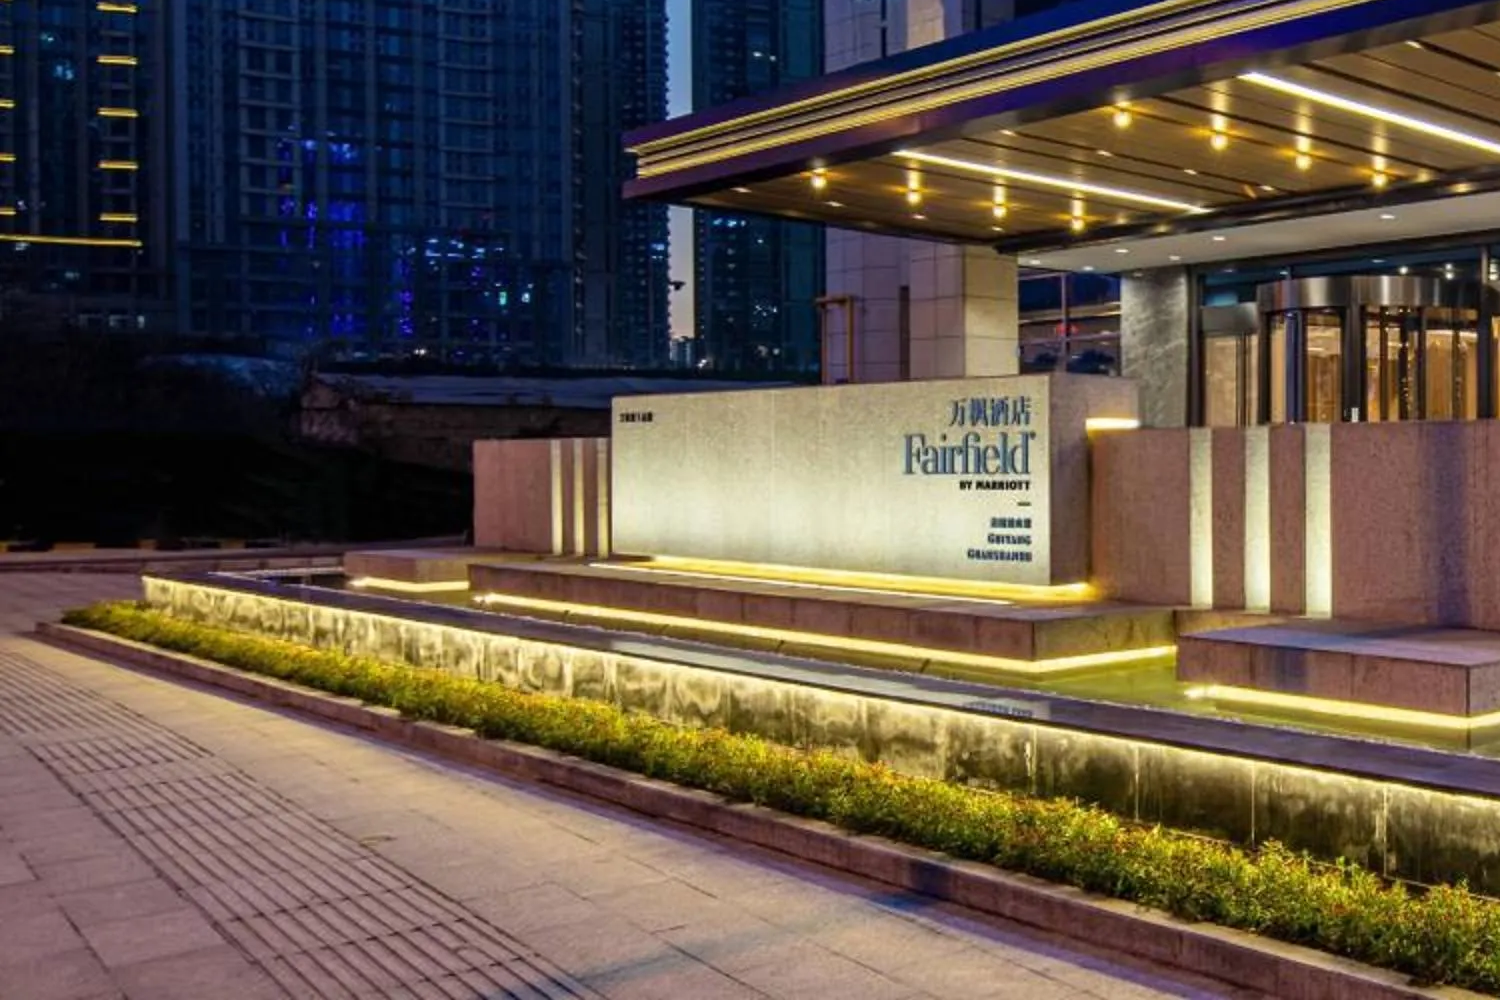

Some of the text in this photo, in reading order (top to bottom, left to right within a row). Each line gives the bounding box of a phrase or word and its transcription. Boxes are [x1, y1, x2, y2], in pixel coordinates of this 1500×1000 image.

[903, 431, 1031, 475] Fairfield
[959, 480, 1030, 491] BY MARRIOTT
